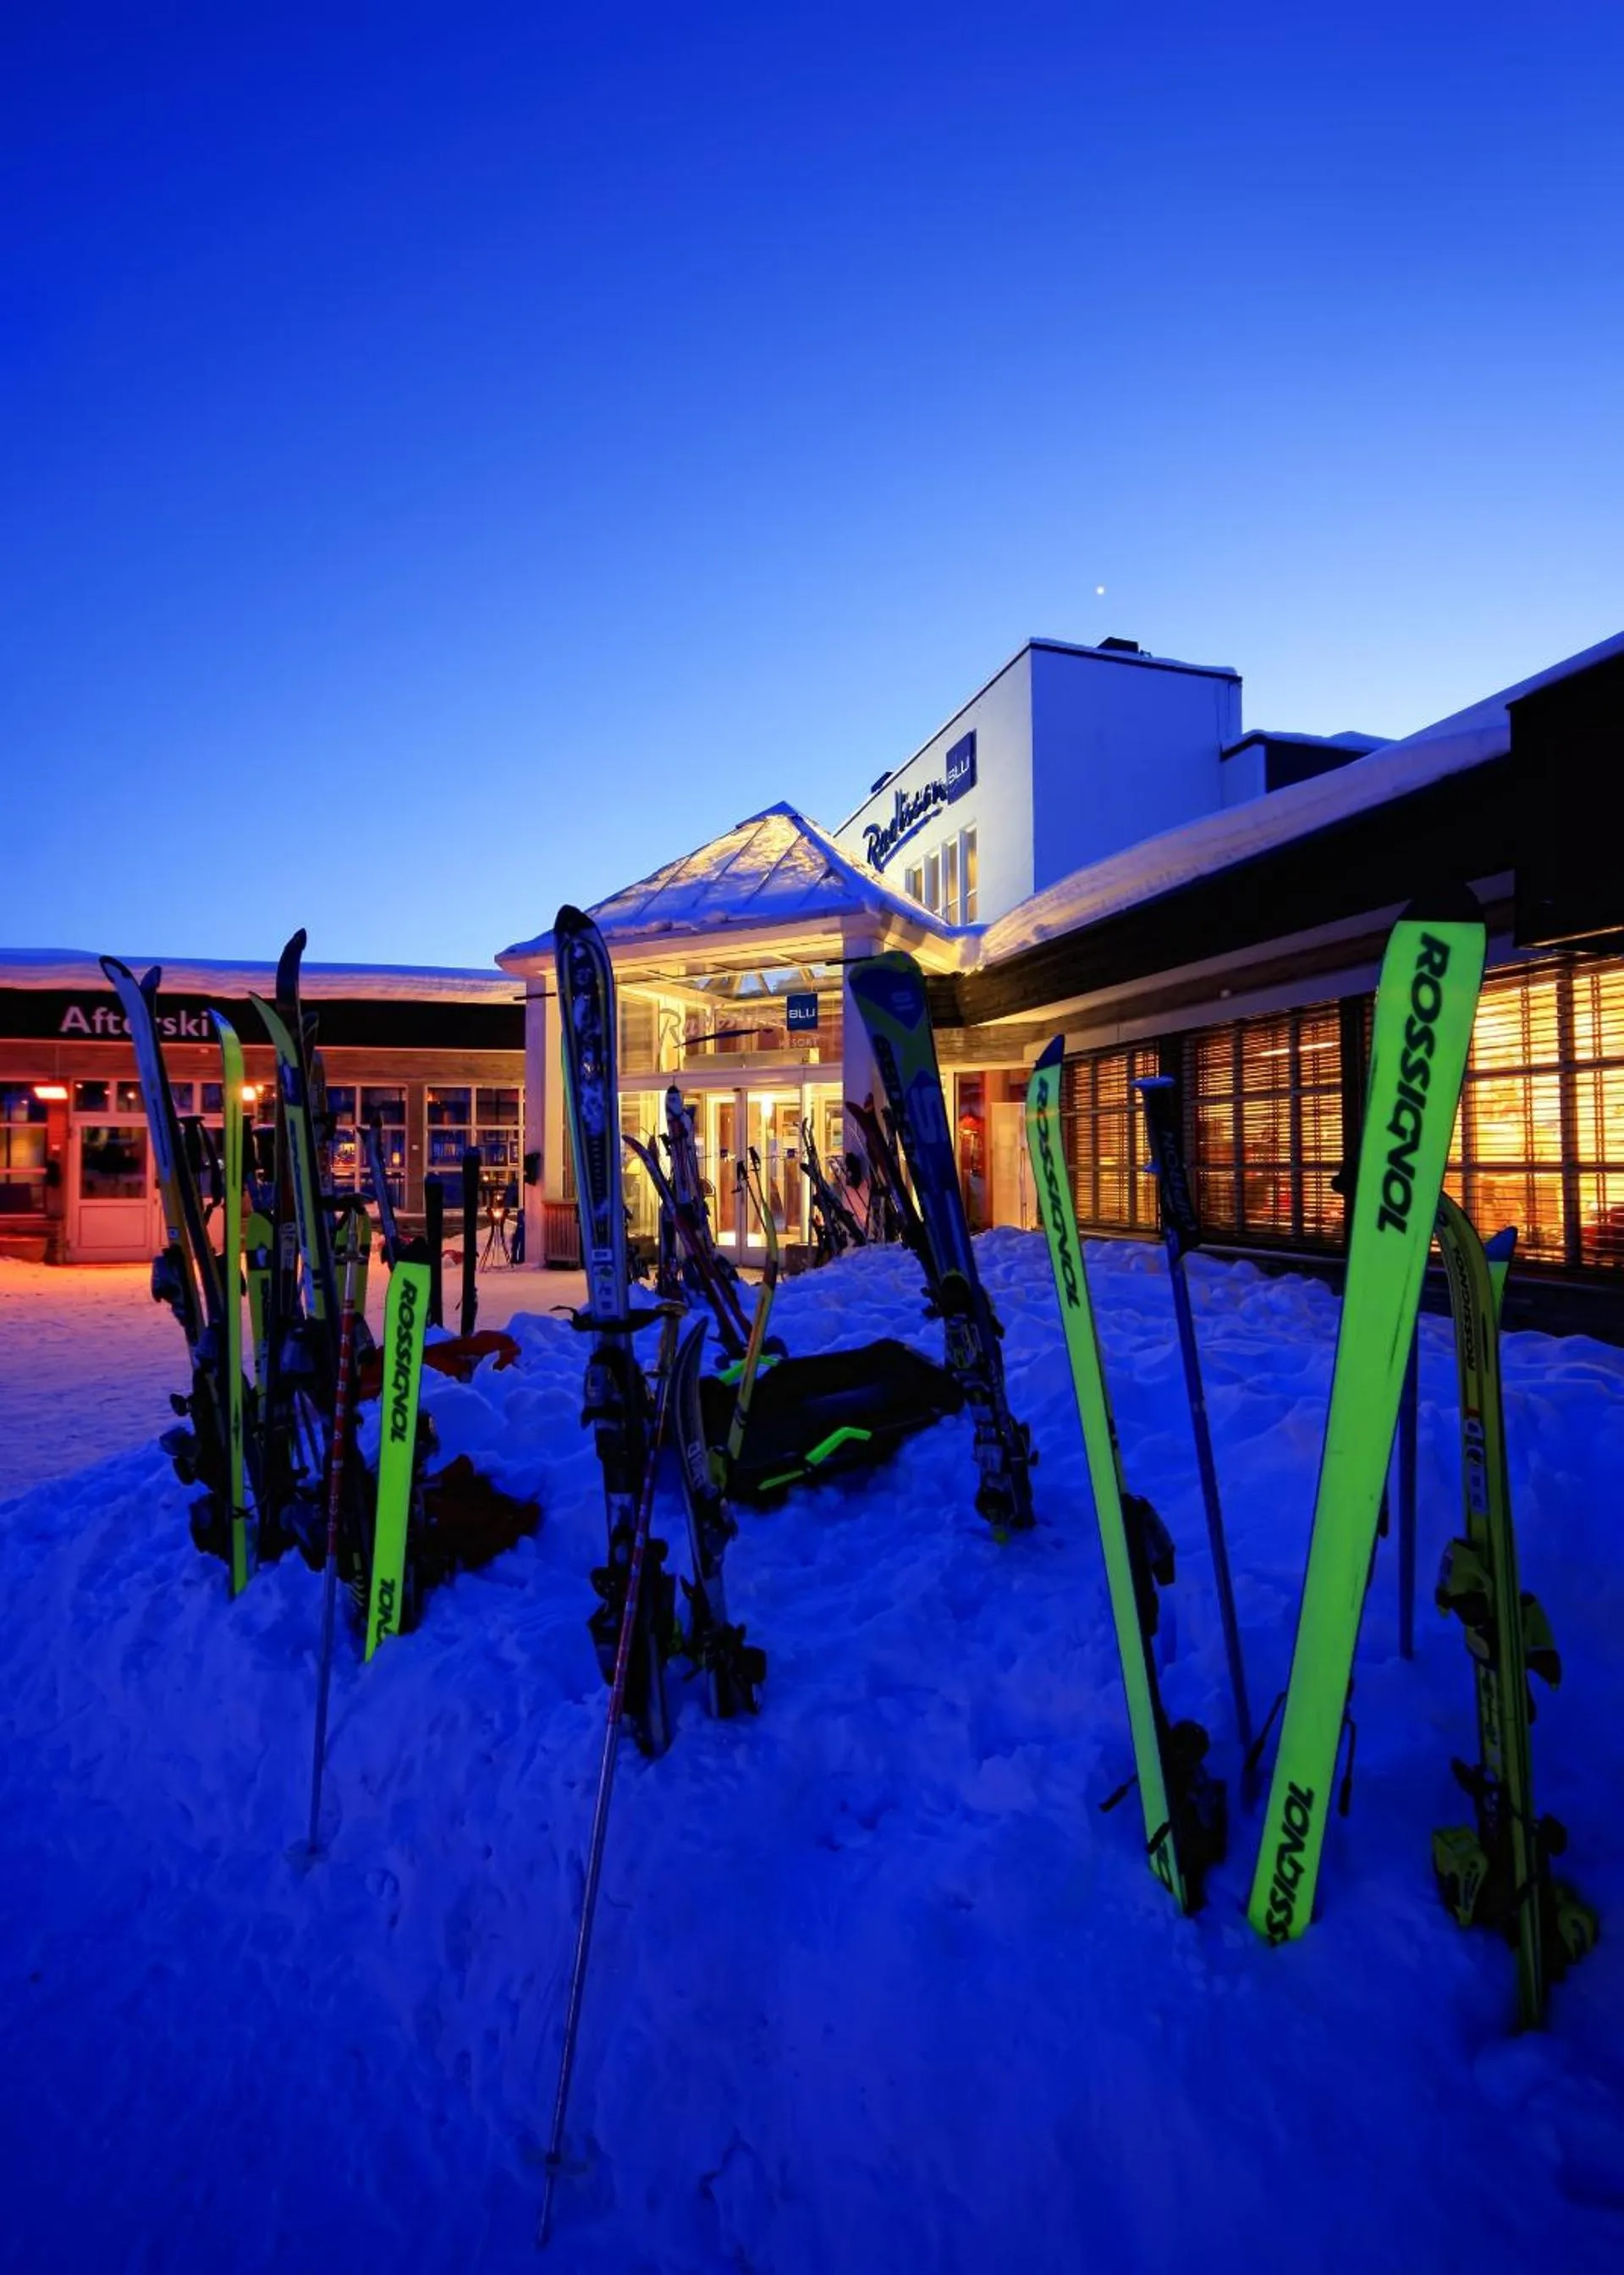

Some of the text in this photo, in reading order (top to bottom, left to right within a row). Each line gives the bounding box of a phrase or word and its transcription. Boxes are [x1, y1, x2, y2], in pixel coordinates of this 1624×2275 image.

[948, 756, 970, 785] BLU
[59, 1005, 209, 1037] Aftski
[789, 1007, 816, 1019] BLU
[1376, 931, 1451, 1234] ROSSIGNOL
[1037, 1076, 1081, 1309] ROSSIGNOL
[390, 1276, 417, 1443] ROSSIGNOL
[1265, 1781, 1315, 1948] SSIGNOL
